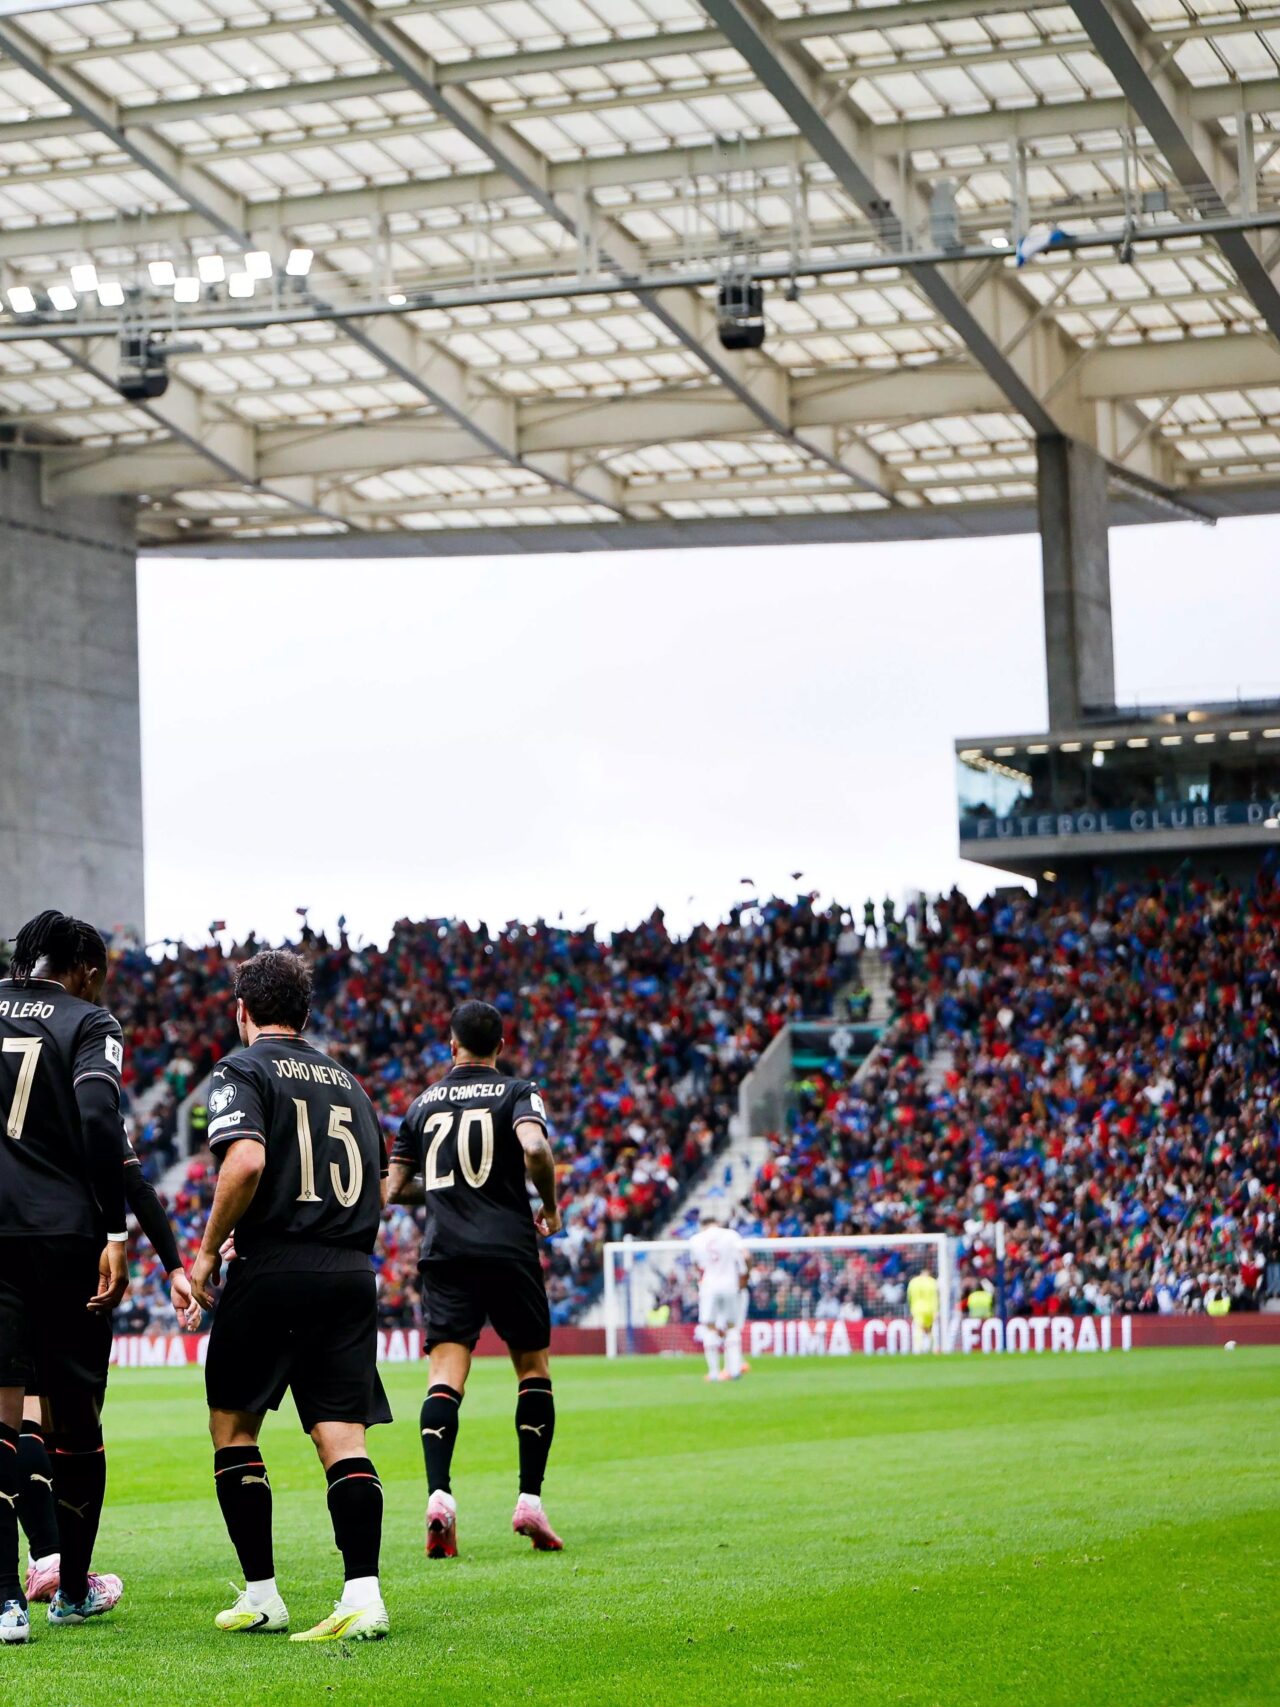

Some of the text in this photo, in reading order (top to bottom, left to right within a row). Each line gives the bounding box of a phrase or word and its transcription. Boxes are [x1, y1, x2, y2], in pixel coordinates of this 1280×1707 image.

[977, 813, 1115, 839] FUTEBOL
[11, 1001, 55, 1019] LEÃO
[272, 1057, 352, 1090] JOÃO NEVES
[449, 1083, 505, 1101] CANCELO
[291, 1097, 363, 1208] 15
[423, 1108, 494, 1191] 20
